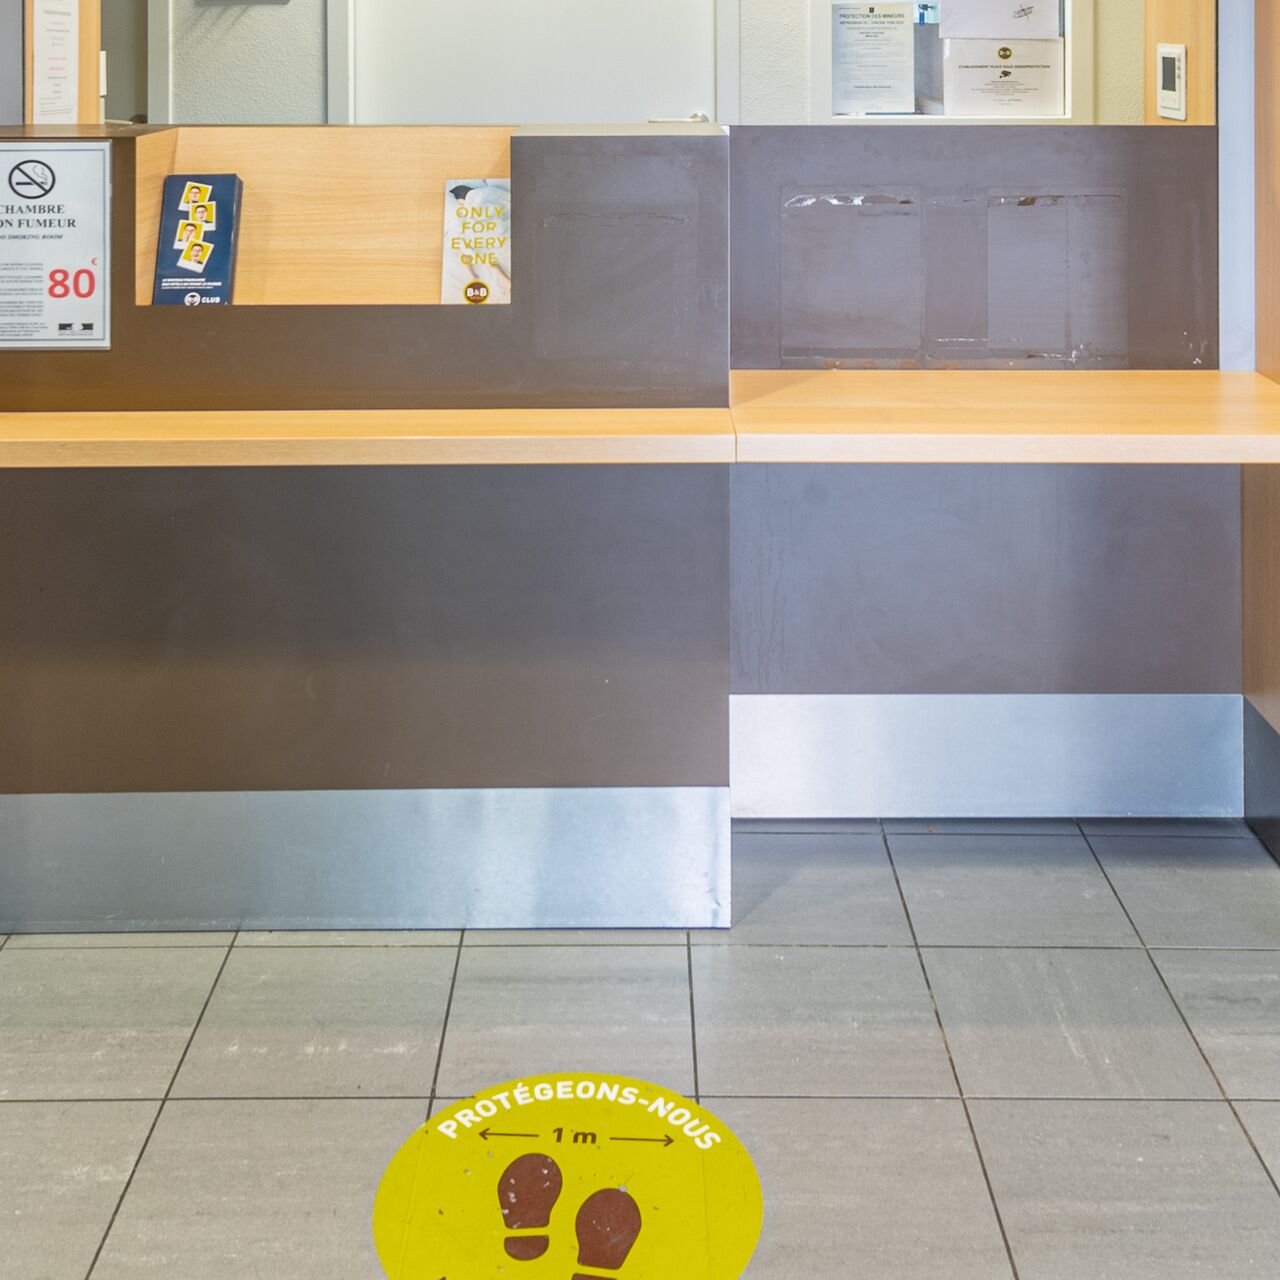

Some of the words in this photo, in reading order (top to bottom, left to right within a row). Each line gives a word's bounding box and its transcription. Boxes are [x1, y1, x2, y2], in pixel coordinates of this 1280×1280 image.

[455, 206, 504, 219] ONLY
[17, 218, 77, 229] FUMEUR
[461, 221, 497, 234] FOR
[7, 233, 40, 241] SMOKING
[41, 233, 64, 241] ROOM
[450, 236, 508, 250] EVERY
[460, 252, 498, 266] ONE
[47, 268, 96, 299] 80
[201, 296, 221, 304] CLUB
[437, 1080, 721, 1151] PROTÉGEONS-NOUS
[552, 1127, 564, 1144] 1
[572, 1129, 598, 1145] m
